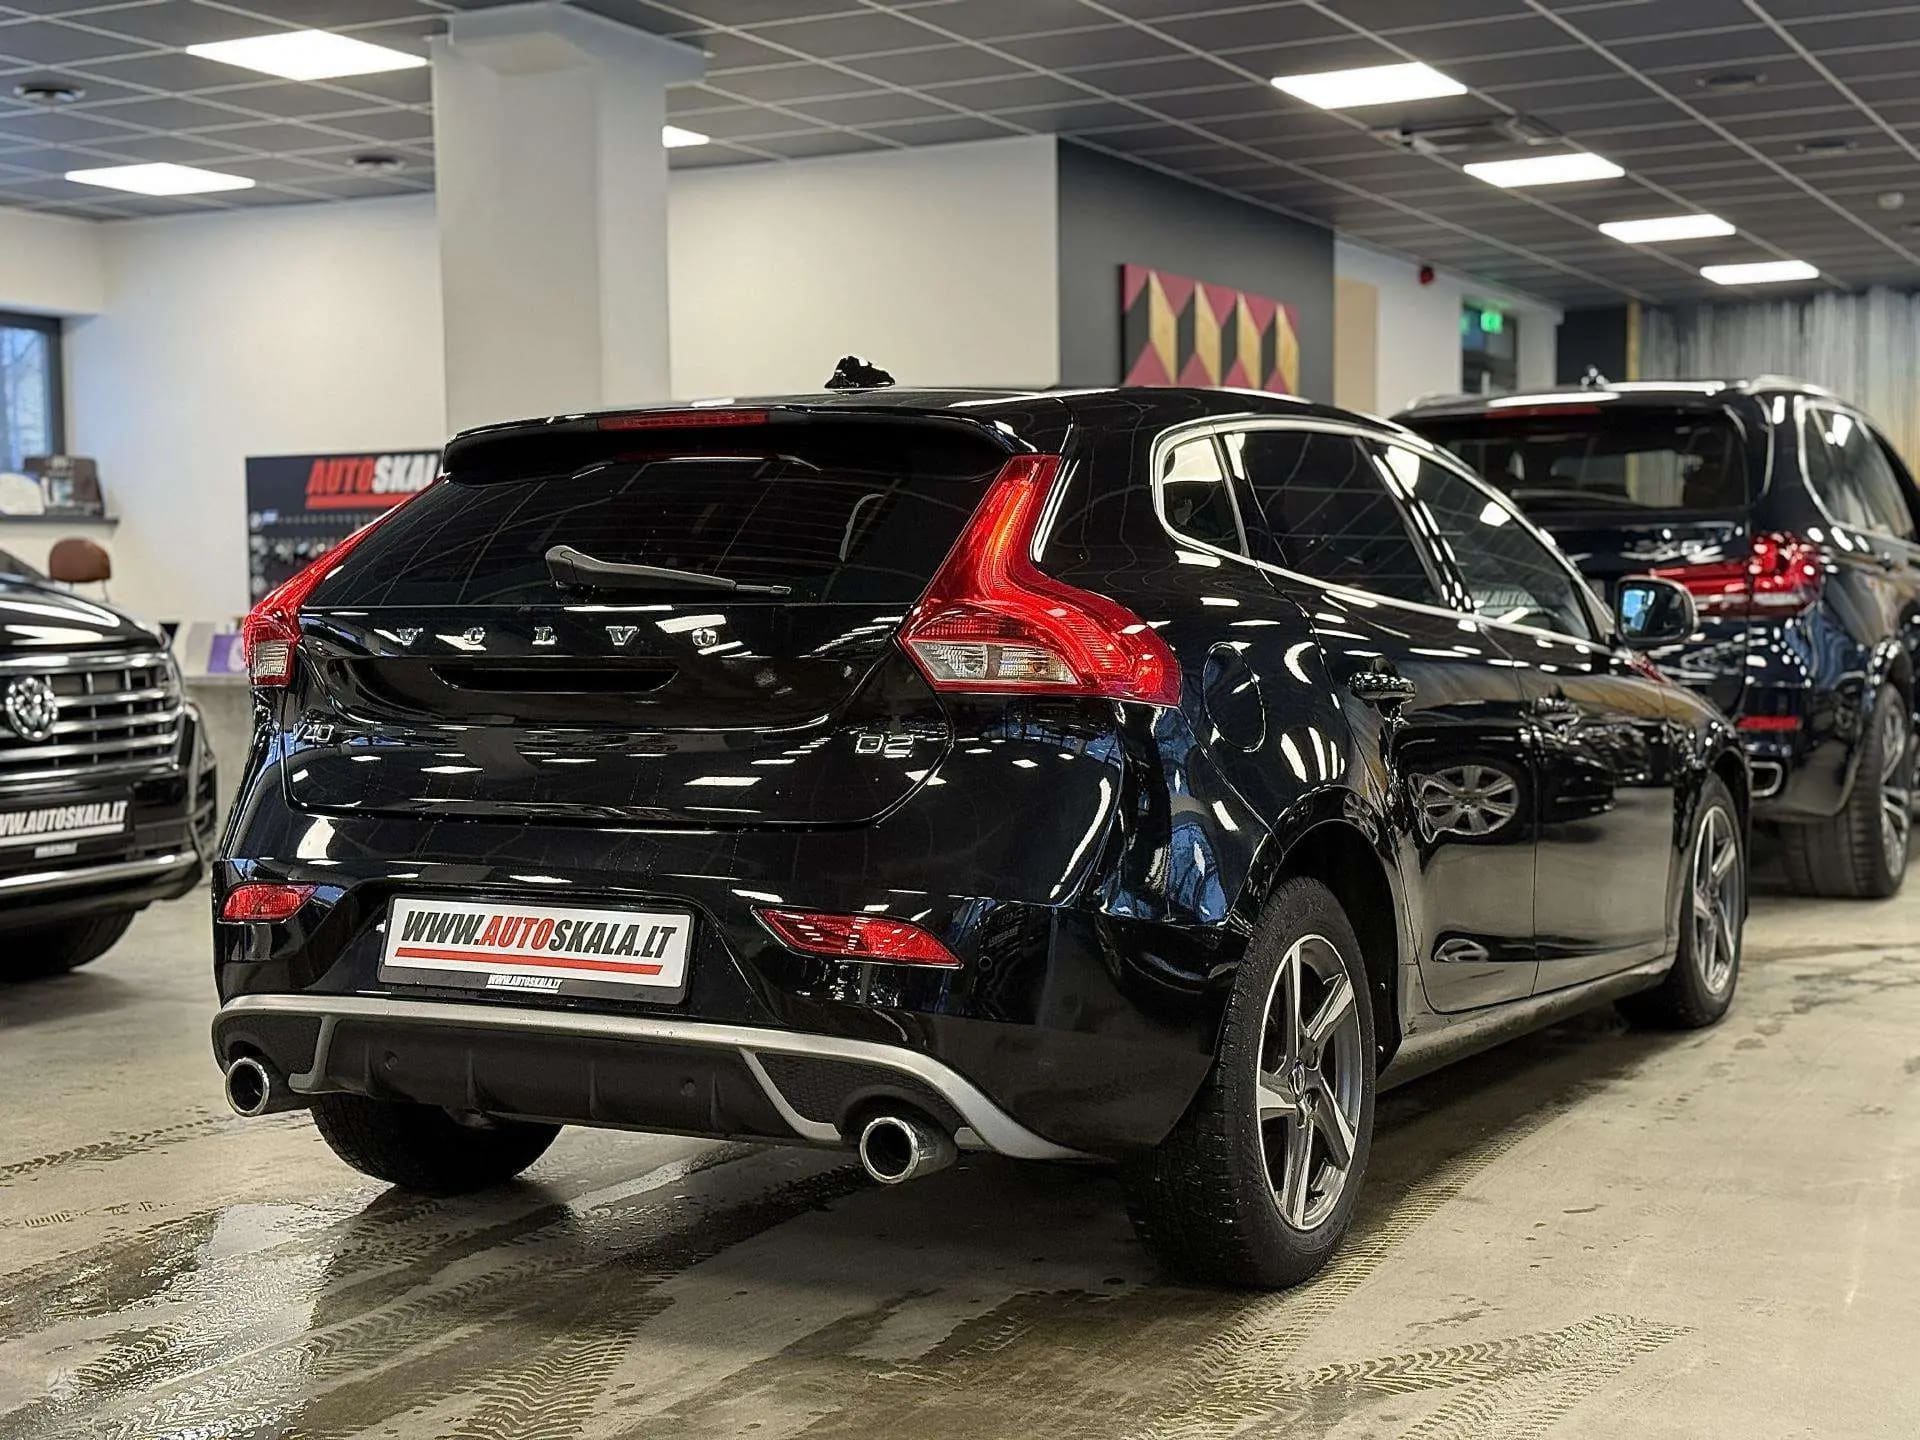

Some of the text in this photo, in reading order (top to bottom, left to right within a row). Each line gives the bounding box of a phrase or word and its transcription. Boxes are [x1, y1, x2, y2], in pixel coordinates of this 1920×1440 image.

[305, 453, 444, 495] AUTOSKAL
[396, 626, 718, 647] VOLVO
[293, 723, 335, 743] V40
[855, 734, 914, 757] D2
[401, 911, 677, 958] WWW.AUTOSKALA.LT
[487, 974, 564, 989] WWW.AUTOSKALA.LT
